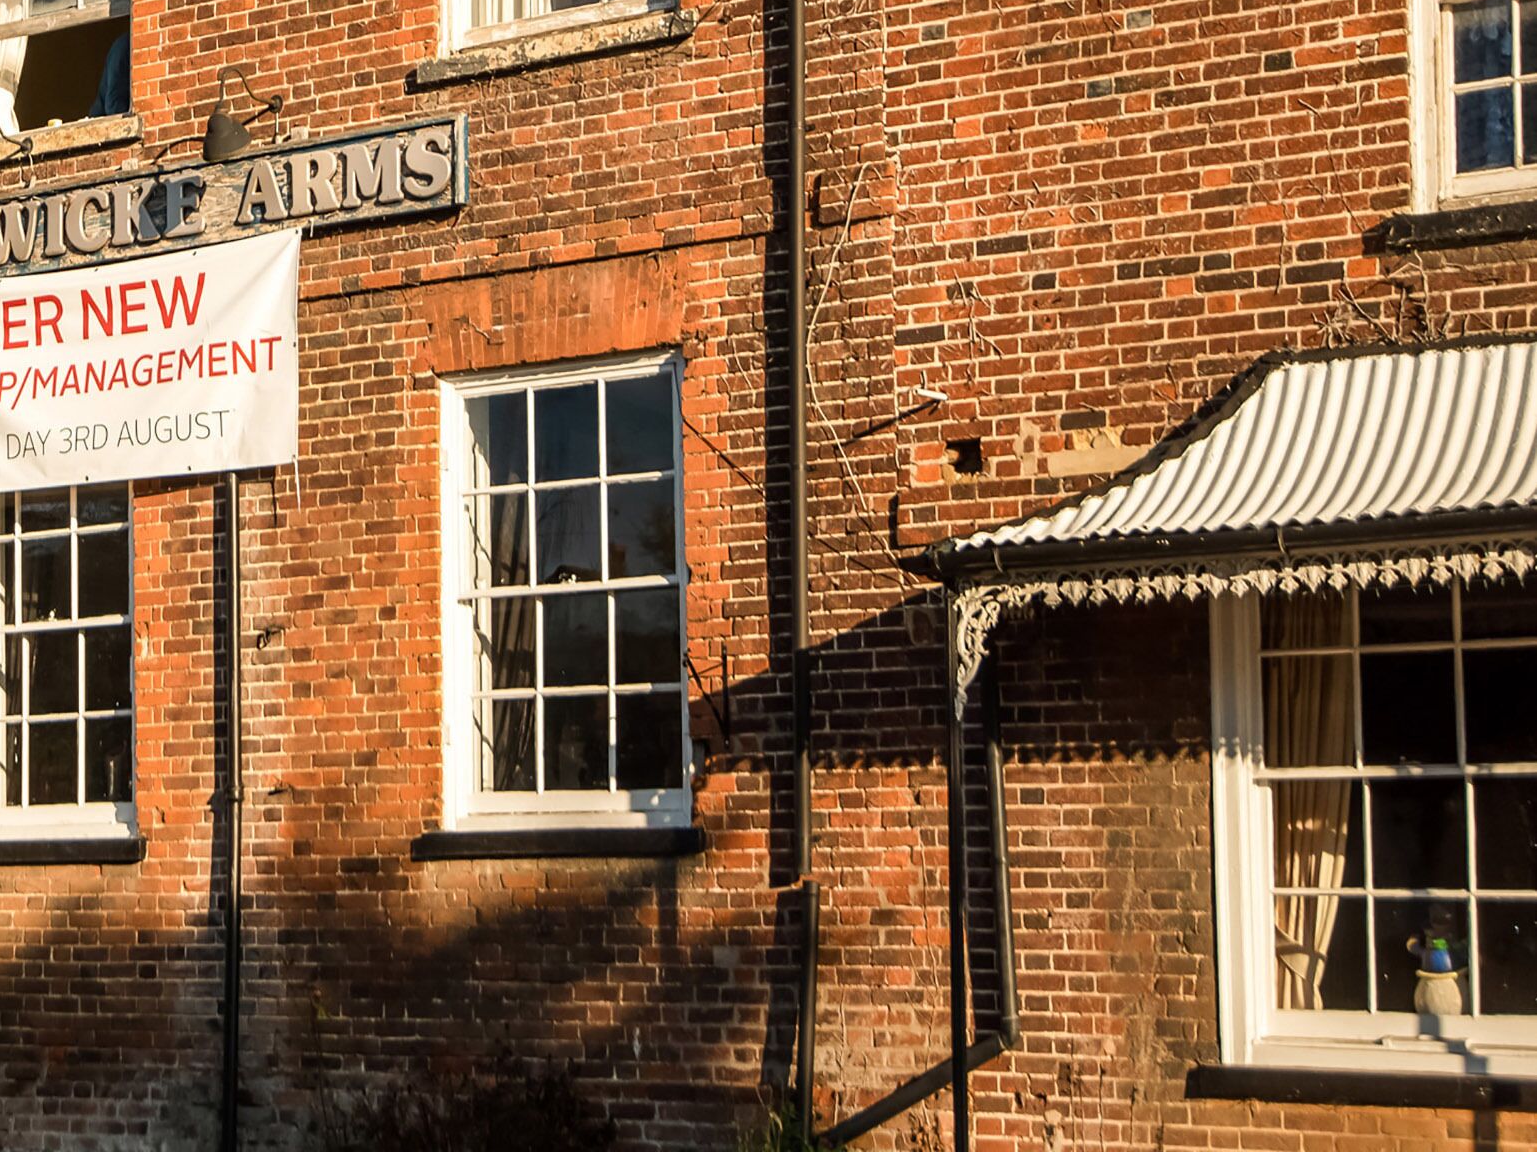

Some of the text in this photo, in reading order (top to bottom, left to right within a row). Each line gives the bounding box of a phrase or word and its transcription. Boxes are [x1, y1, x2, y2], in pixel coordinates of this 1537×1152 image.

[237, 127, 453, 224] ARMS
[81, 272, 207, 340] NEW
[5, 429, 50, 461] DAY
[59, 423, 109, 453] 3RD
[117, 409, 231, 447] AUGUST
